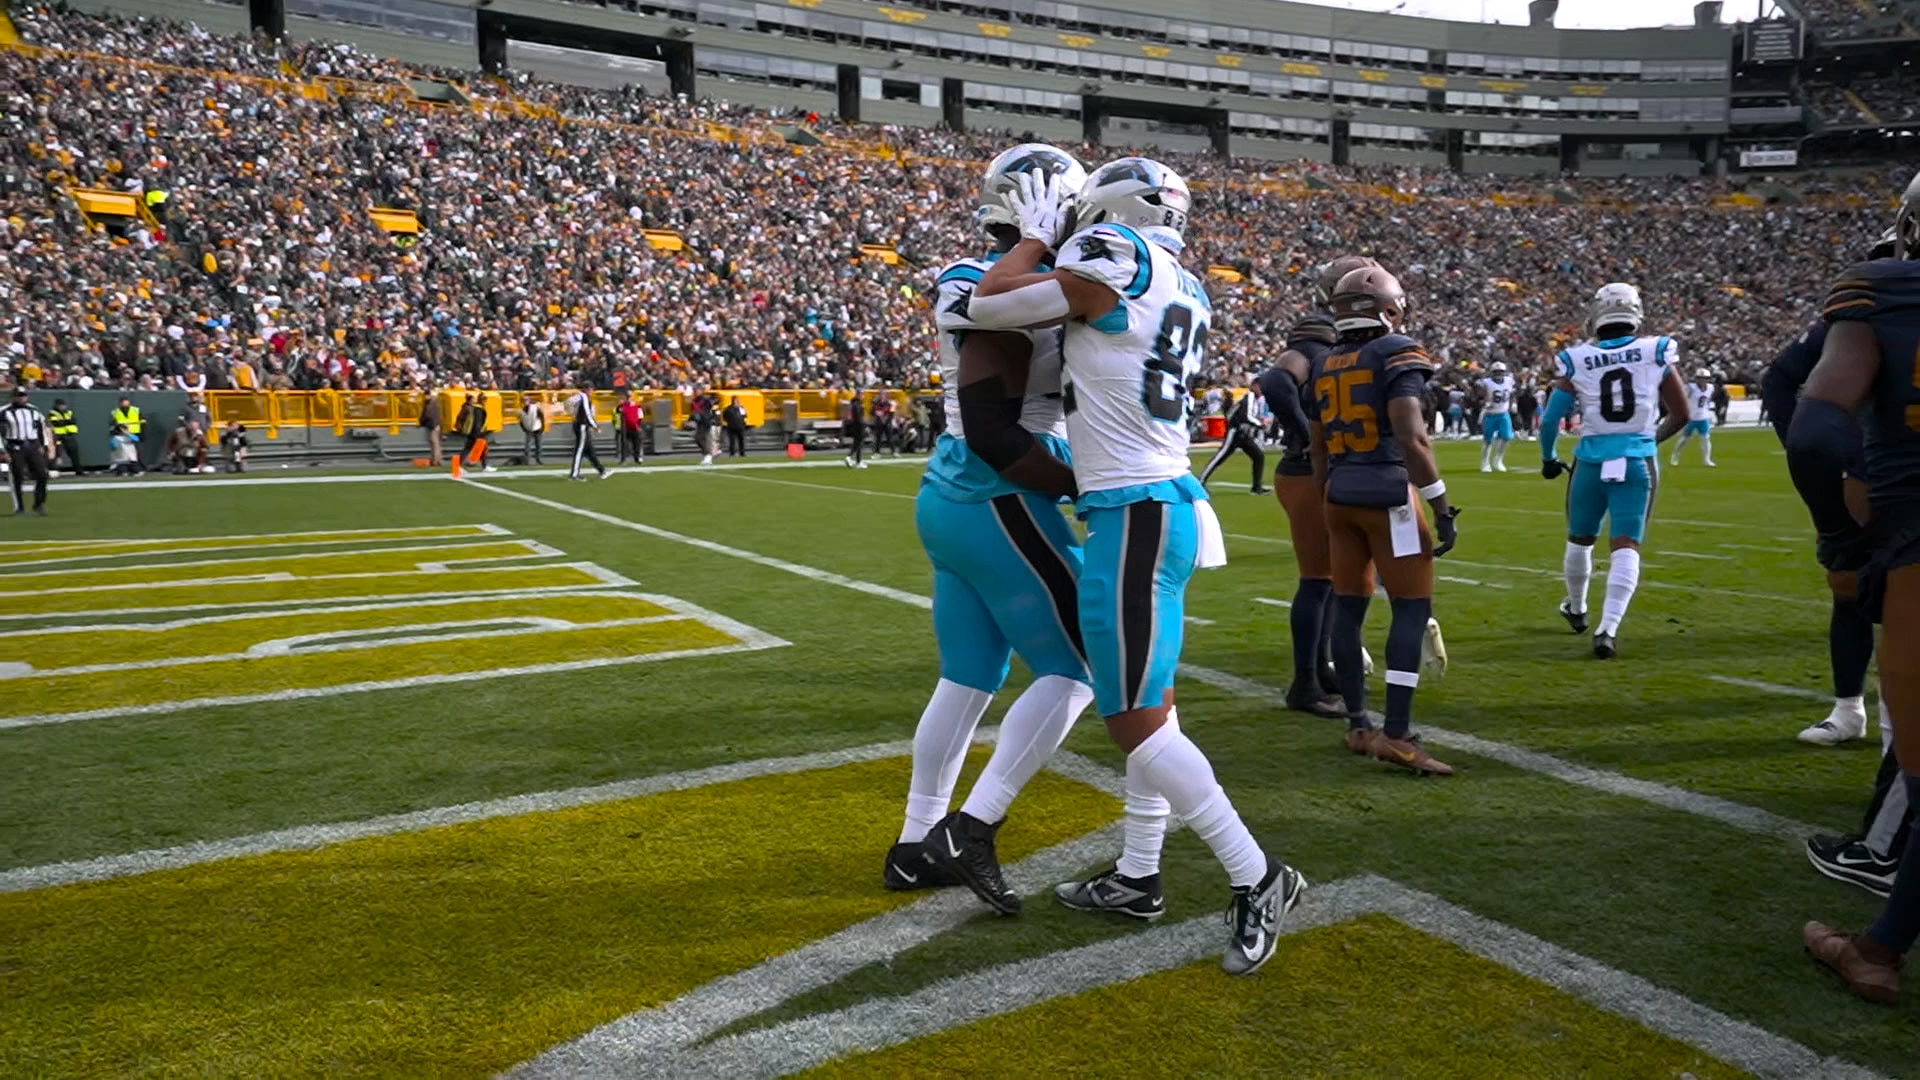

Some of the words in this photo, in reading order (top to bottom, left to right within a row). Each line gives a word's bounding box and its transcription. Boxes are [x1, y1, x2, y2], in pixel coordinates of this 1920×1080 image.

[1164, 210, 1184, 230] 82
[1584, 348, 1642, 370] SANDERS
[1314, 370, 1379, 454] 25
[1600, 367, 1635, 423] 0
